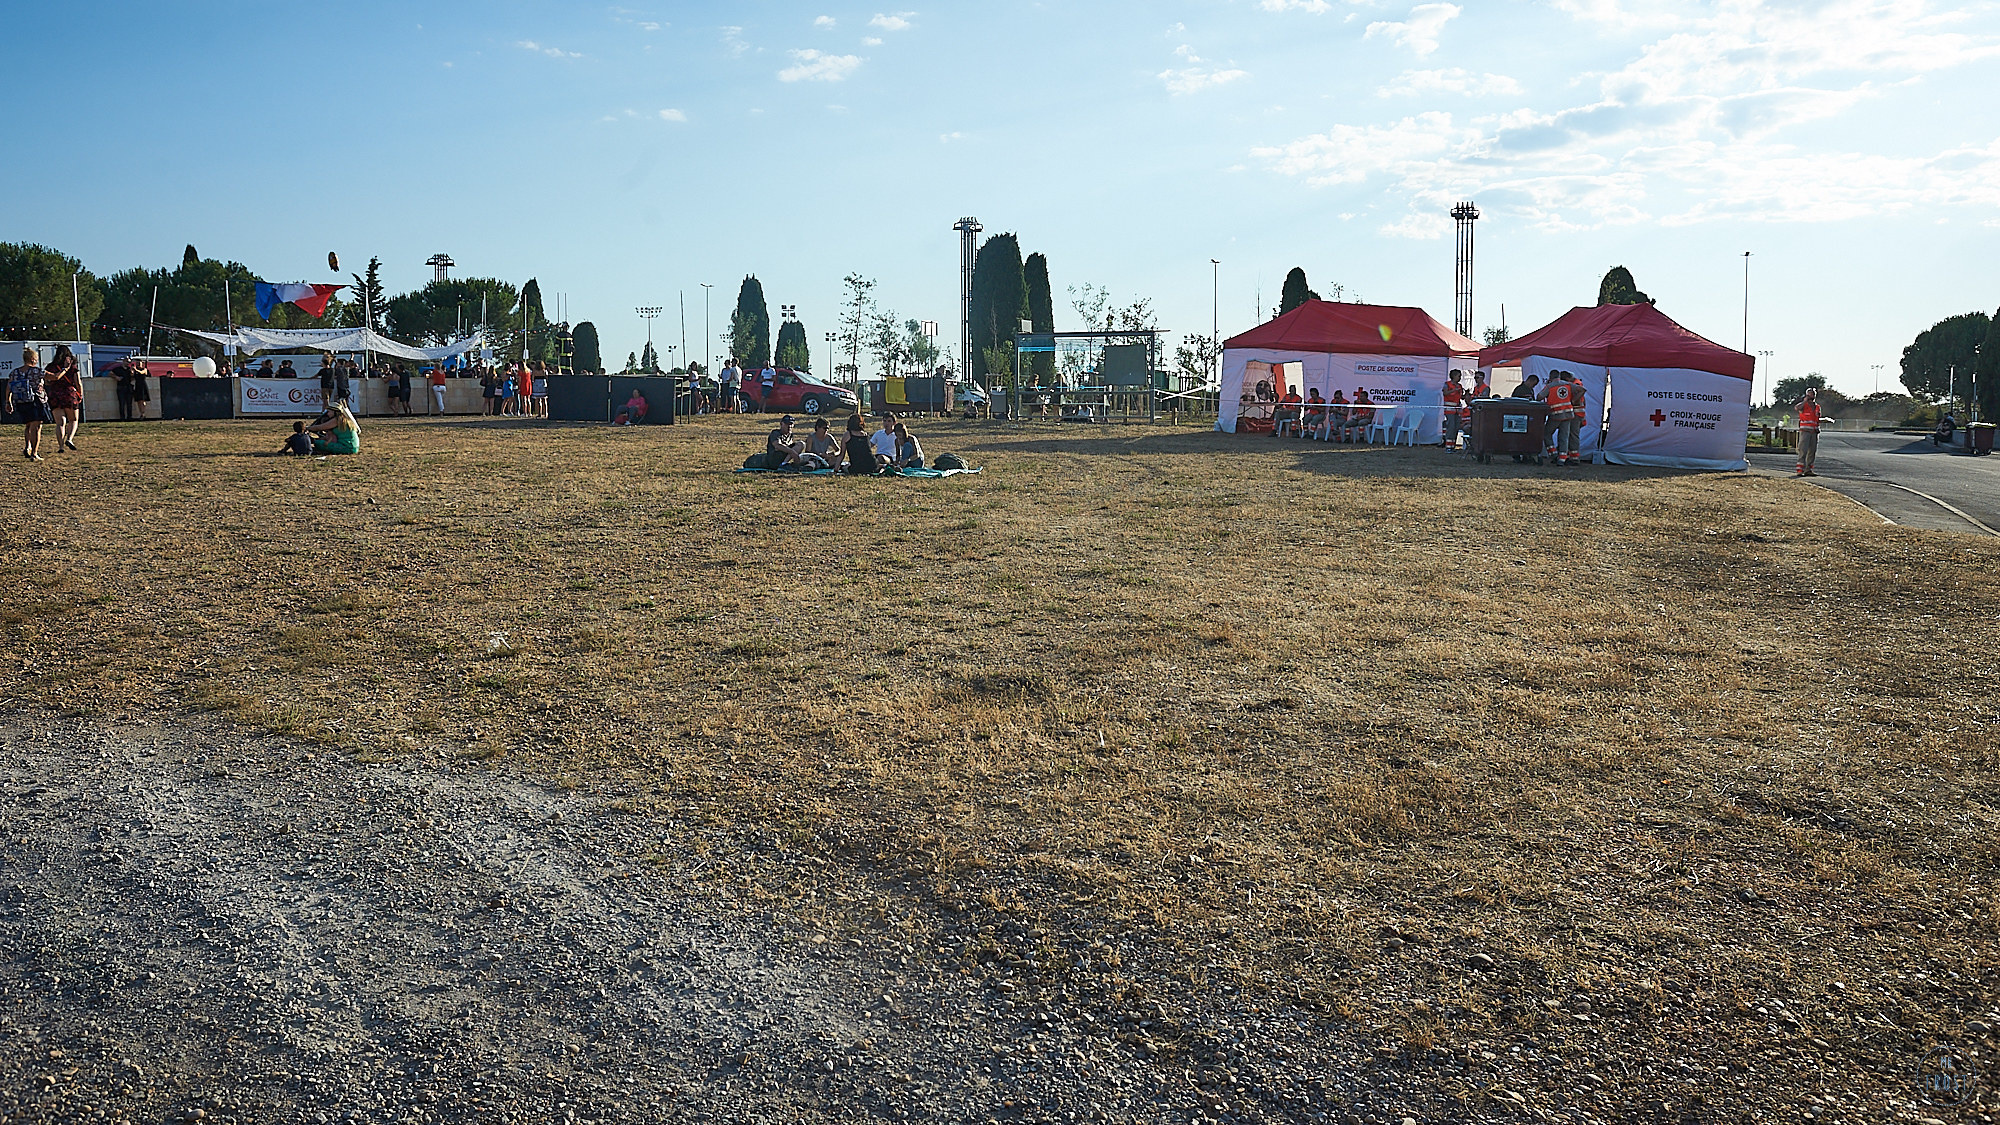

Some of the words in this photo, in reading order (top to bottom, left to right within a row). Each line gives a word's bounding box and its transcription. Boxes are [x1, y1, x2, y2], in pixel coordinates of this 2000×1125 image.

[1369, 388, 1416, 397] CROIX-ROUGE
[1647, 391, 1674, 399] POSTE
[1674, 392, 1685, 400] DE
[1686, 392, 1723, 402] SECOURS
[1372, 395, 1410, 403] FRANÇAISE
[1669, 410, 1722, 422] CROIX-ROUGE
[1673, 420, 1716, 430] FRANÇAISE
